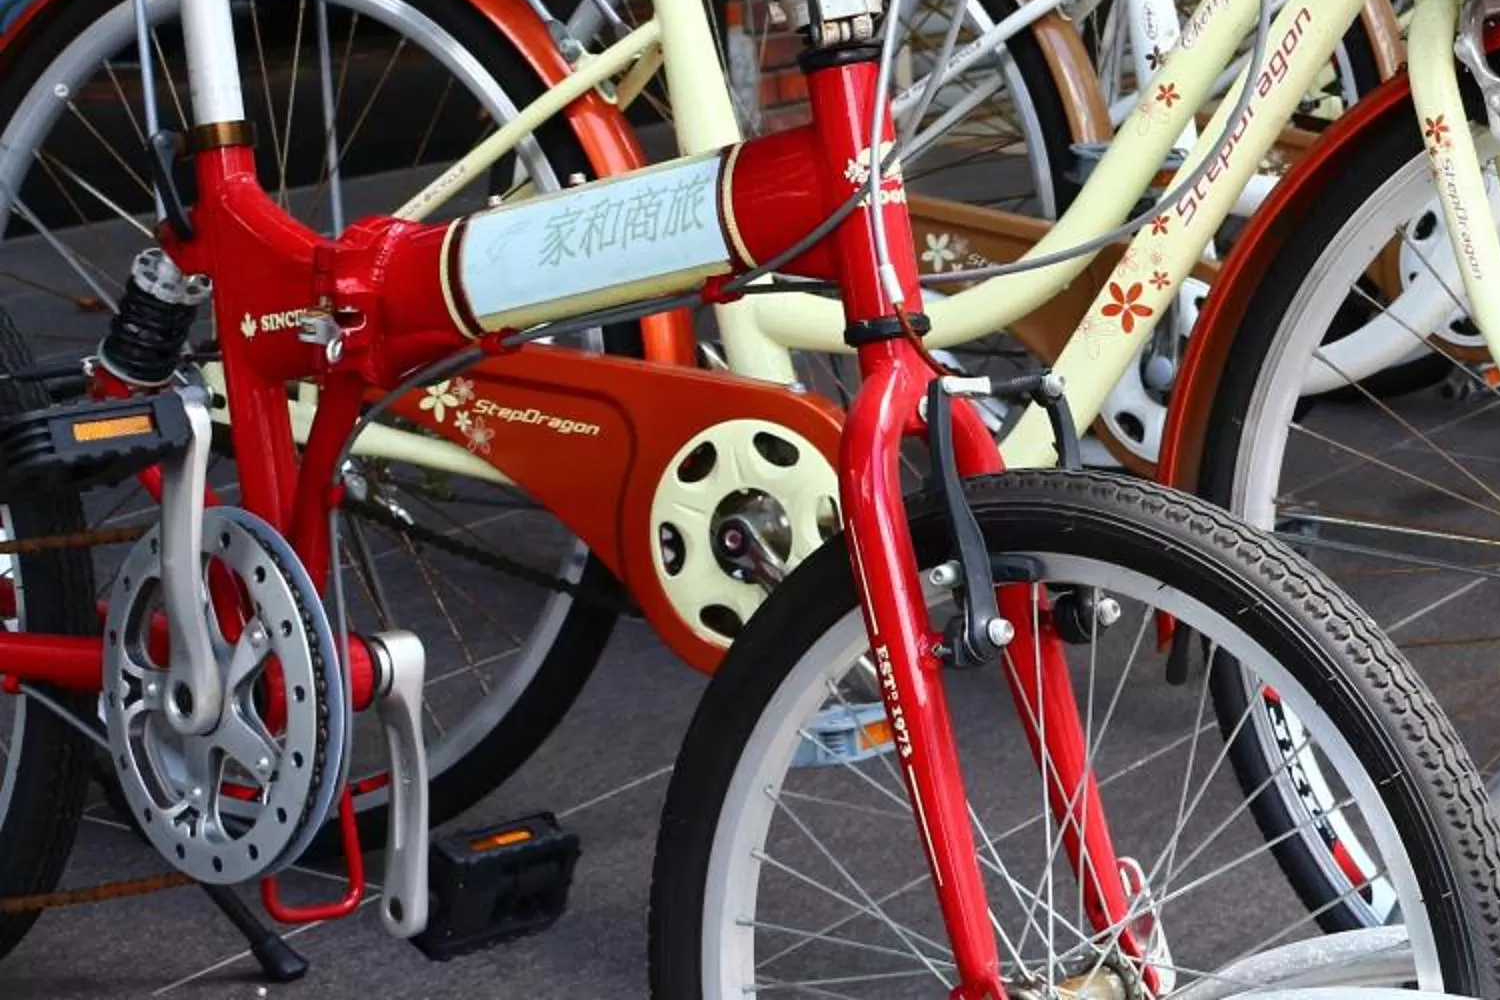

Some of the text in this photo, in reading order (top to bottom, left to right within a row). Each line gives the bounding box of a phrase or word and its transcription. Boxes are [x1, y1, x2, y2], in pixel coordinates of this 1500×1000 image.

[538, 174, 711, 267] 家和商旅
[471, 398, 601, 437] StepDragon
[892, 705, 912, 757] 1973
